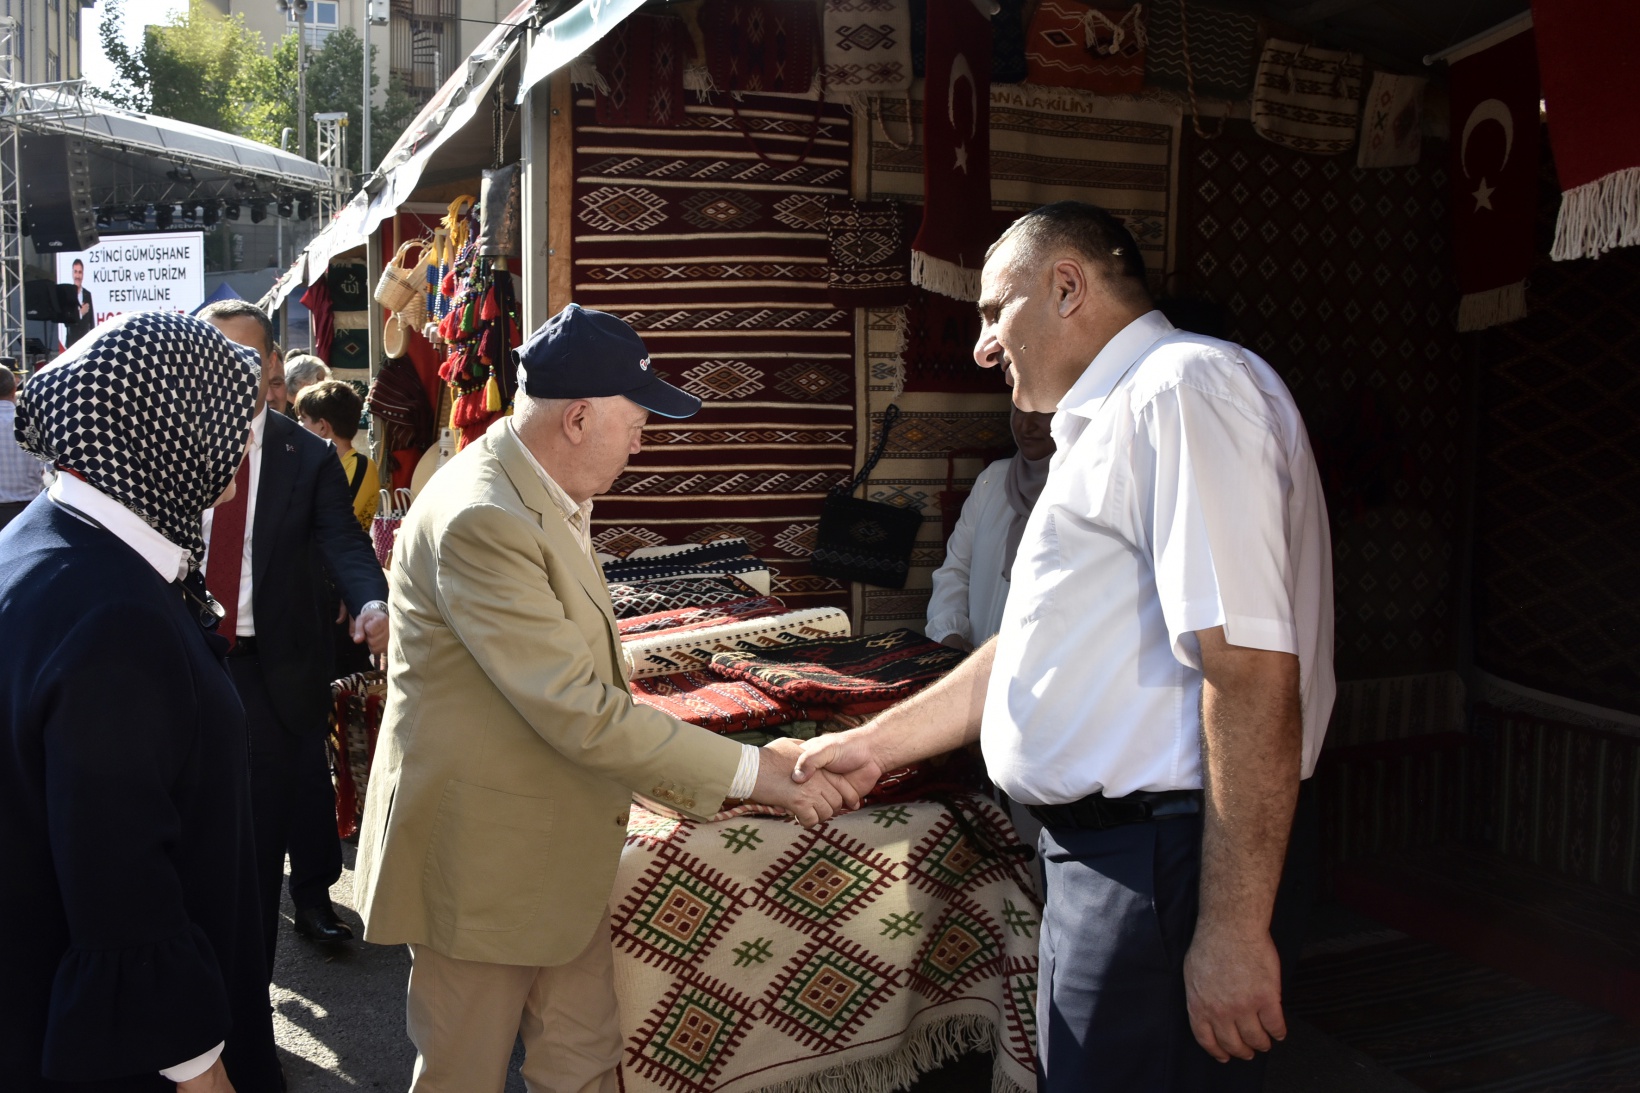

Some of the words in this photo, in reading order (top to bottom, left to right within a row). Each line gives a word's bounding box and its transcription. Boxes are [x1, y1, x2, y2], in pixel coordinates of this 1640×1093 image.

[124, 244, 190, 264] GÜMÜŞHANE
[93, 266, 132, 283] KÜLTÜR
[133, 271, 145, 281] ve
[147, 264, 187, 281] TURİZM
[109, 285, 170, 302] FESTİVALİNE
